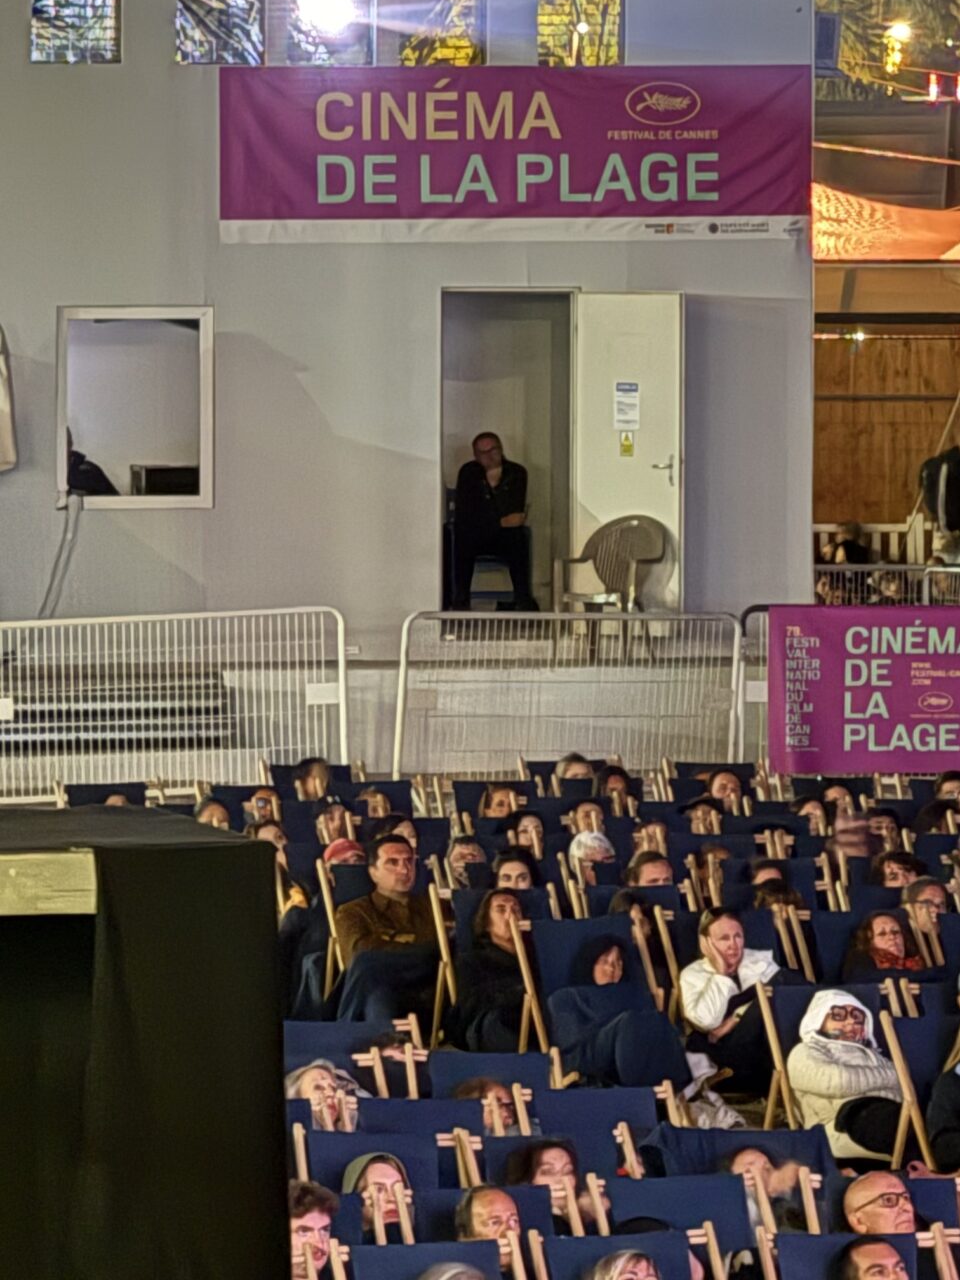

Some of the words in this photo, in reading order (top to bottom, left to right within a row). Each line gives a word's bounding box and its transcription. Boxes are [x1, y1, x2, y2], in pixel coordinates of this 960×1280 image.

[315, 79, 562, 141] CINÉMA
[607, 129, 656, 141] FESTIVAL
[658, 129, 673, 141] DE
[674, 129, 719, 141] CANNES
[317, 155, 398, 205] DE
[420, 154, 498, 205] LA
[516, 153, 720, 204] PLAGE
[786, 637, 820, 647] FESTI
[786, 648, 809, 658] VAL
[786, 659, 820, 669] INTER
[786, 670, 821, 680] NATIO
[845, 659, 893, 687] DE
[786, 681, 808, 691] NAL
[786, 692, 803, 702] DU
[786, 703, 813, 713] FILM
[844, 692, 889, 720] LA
[786, 724, 810, 735] CAN
[786, 736, 809, 746] NES
[844, 724, 960, 753] PLAGE
